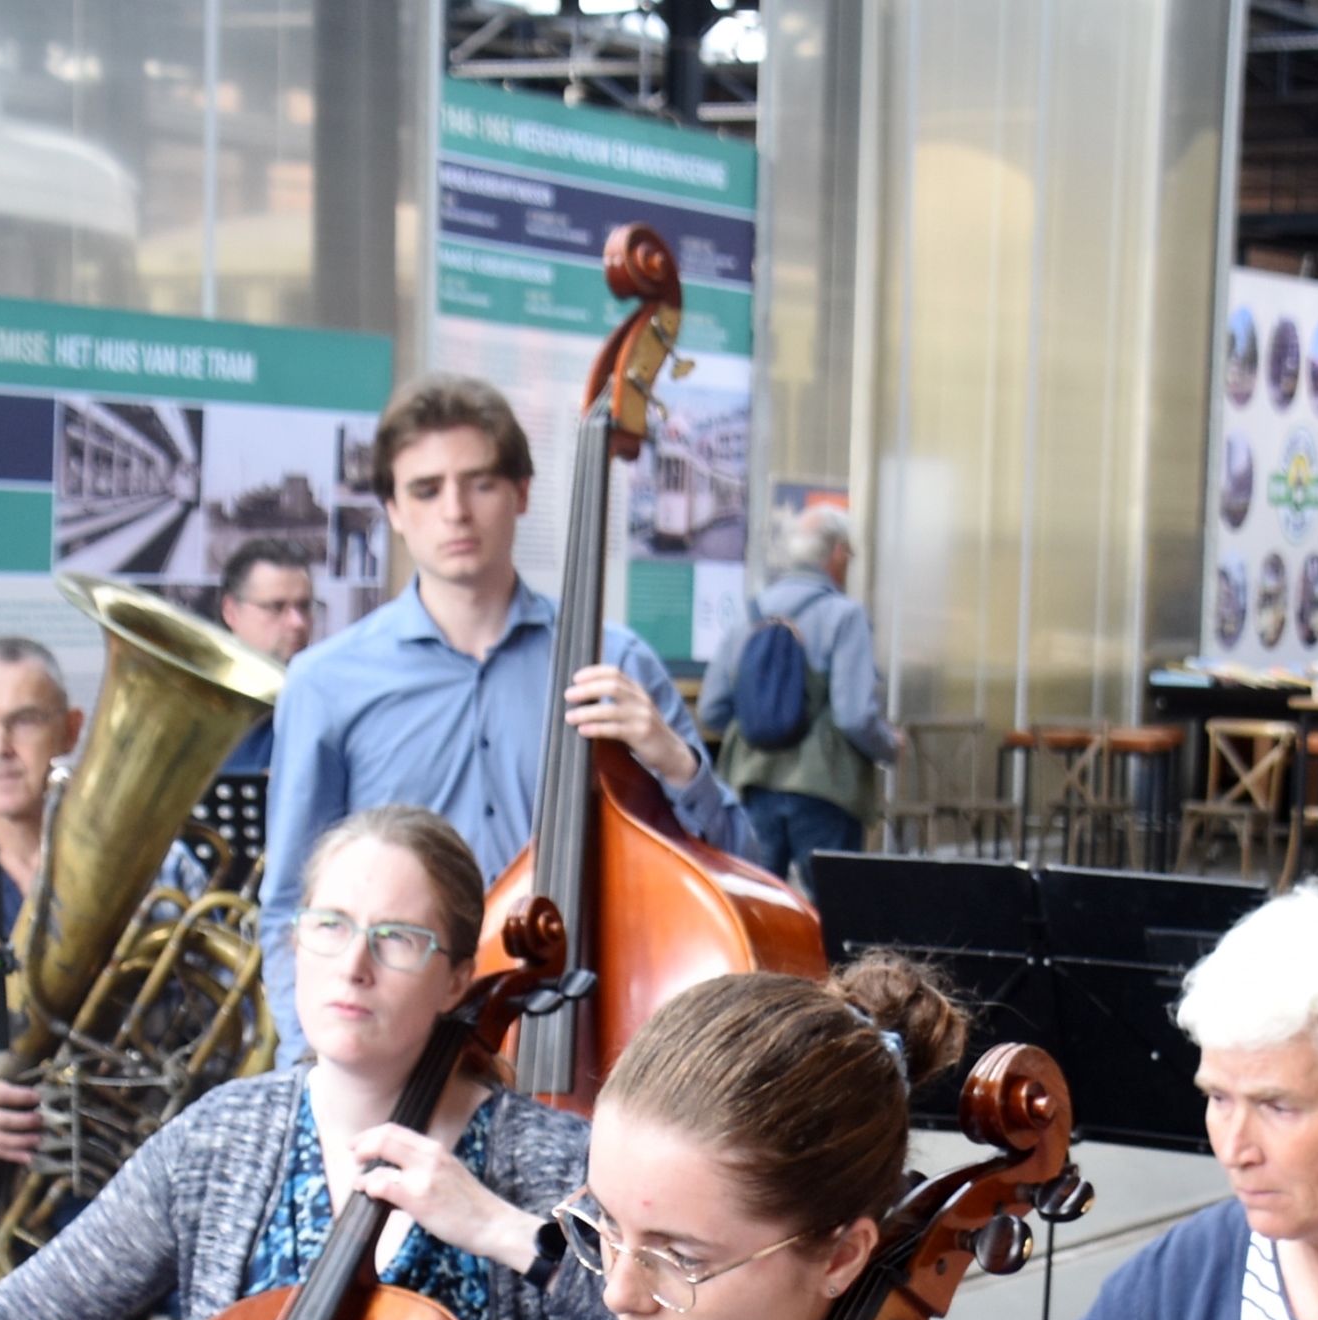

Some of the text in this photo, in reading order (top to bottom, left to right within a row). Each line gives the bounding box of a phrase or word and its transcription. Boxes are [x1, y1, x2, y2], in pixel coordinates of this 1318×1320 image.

[55, 333, 92, 370] HET
[94, 337, 139, 374] HUIS
[140, 341, 179, 377] VAN
[180, 345, 205, 381] DE
[207, 348, 256, 384] TRAM
